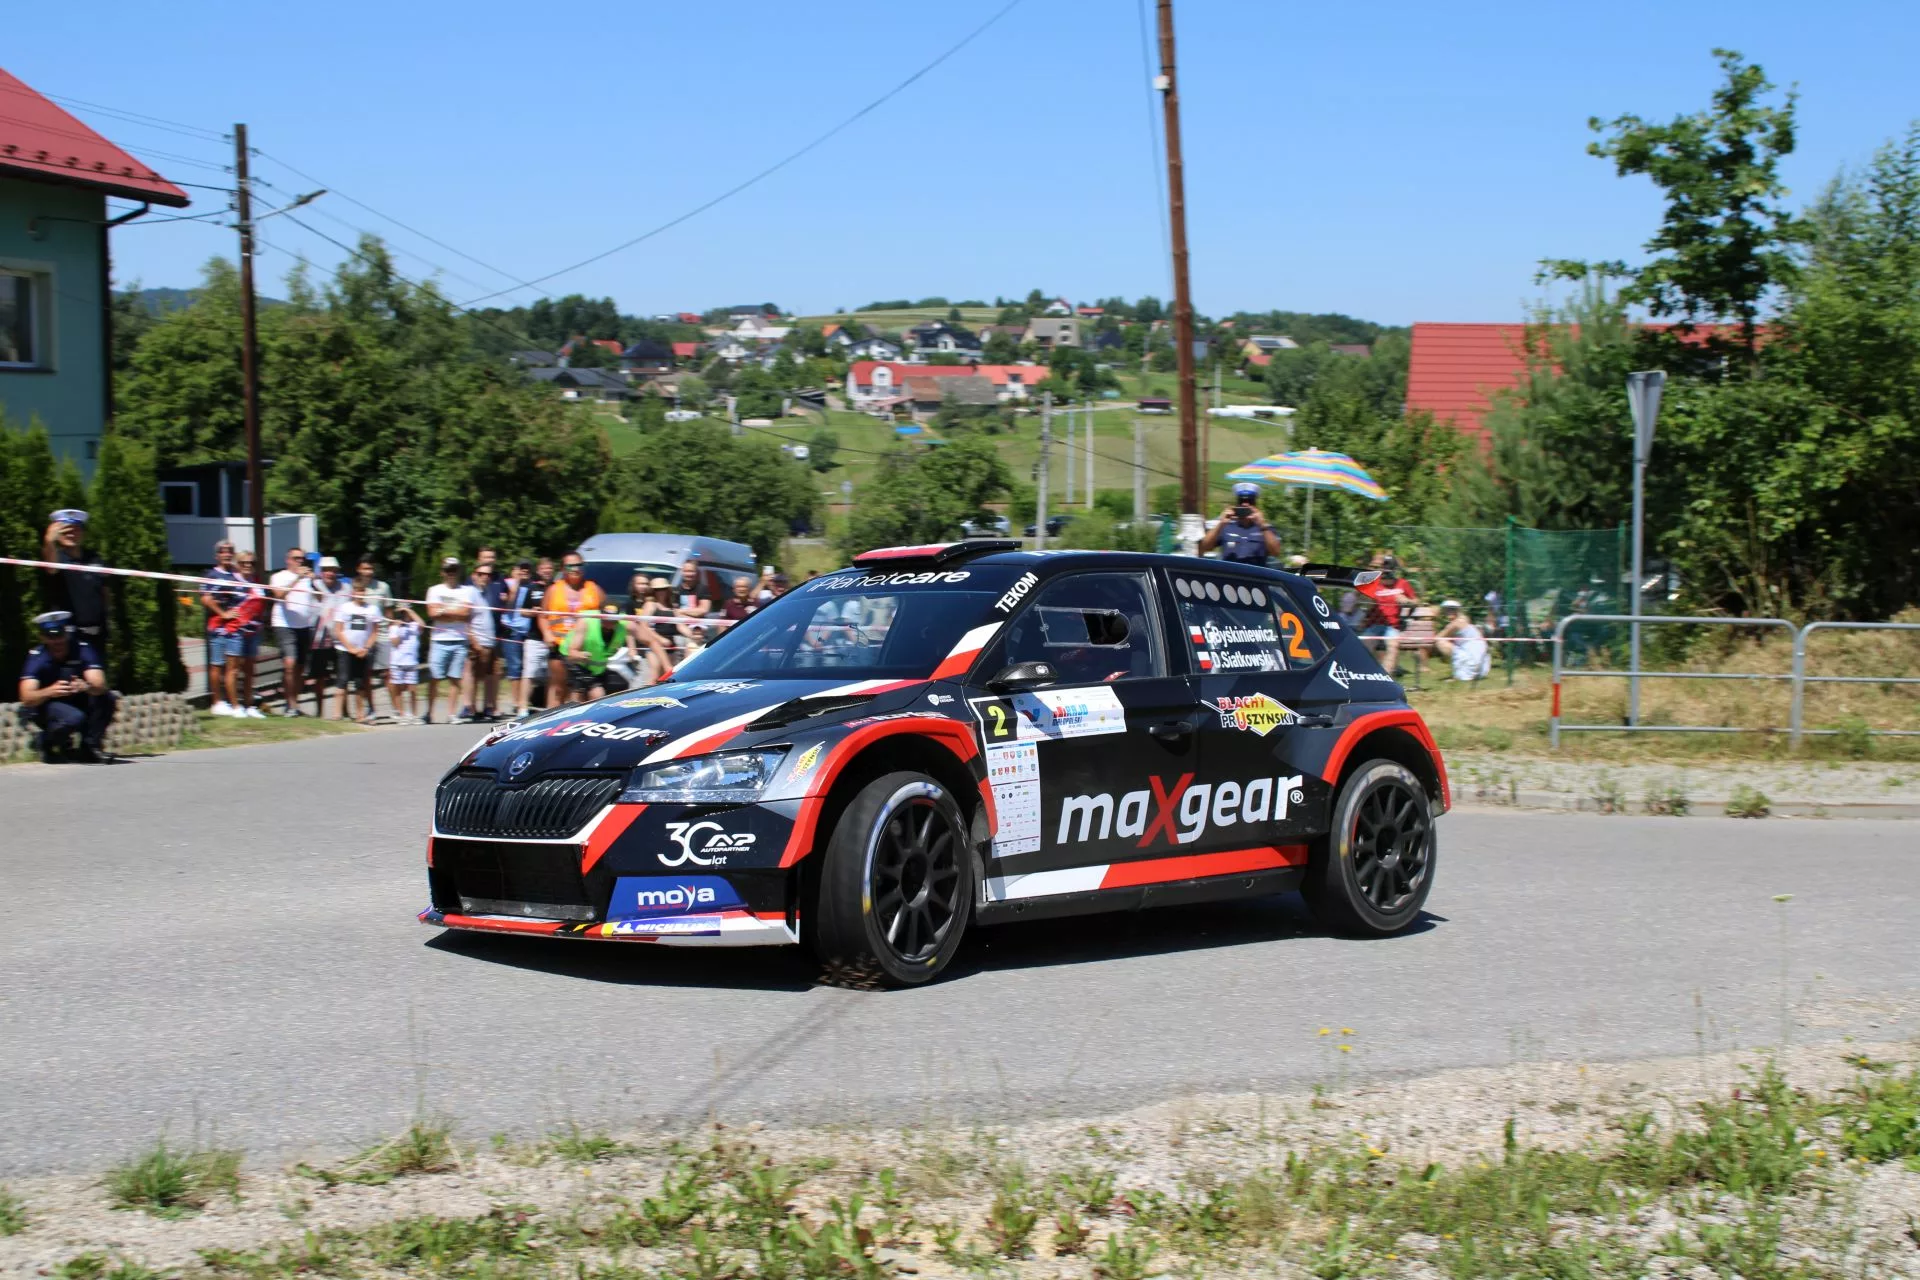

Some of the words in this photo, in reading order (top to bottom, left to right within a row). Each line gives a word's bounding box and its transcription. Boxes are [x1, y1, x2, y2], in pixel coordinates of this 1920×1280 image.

[995, 572, 1039, 613] TEKOM
[1280, 612, 1313, 659] 2
[1217, 696, 1265, 710] BLACHY
[987, 705, 1009, 737] 2
[1221, 711, 1294, 731] PRUSZYŃSKI
[711, 855, 728, 865] lat
[637, 884, 715, 912] moya
